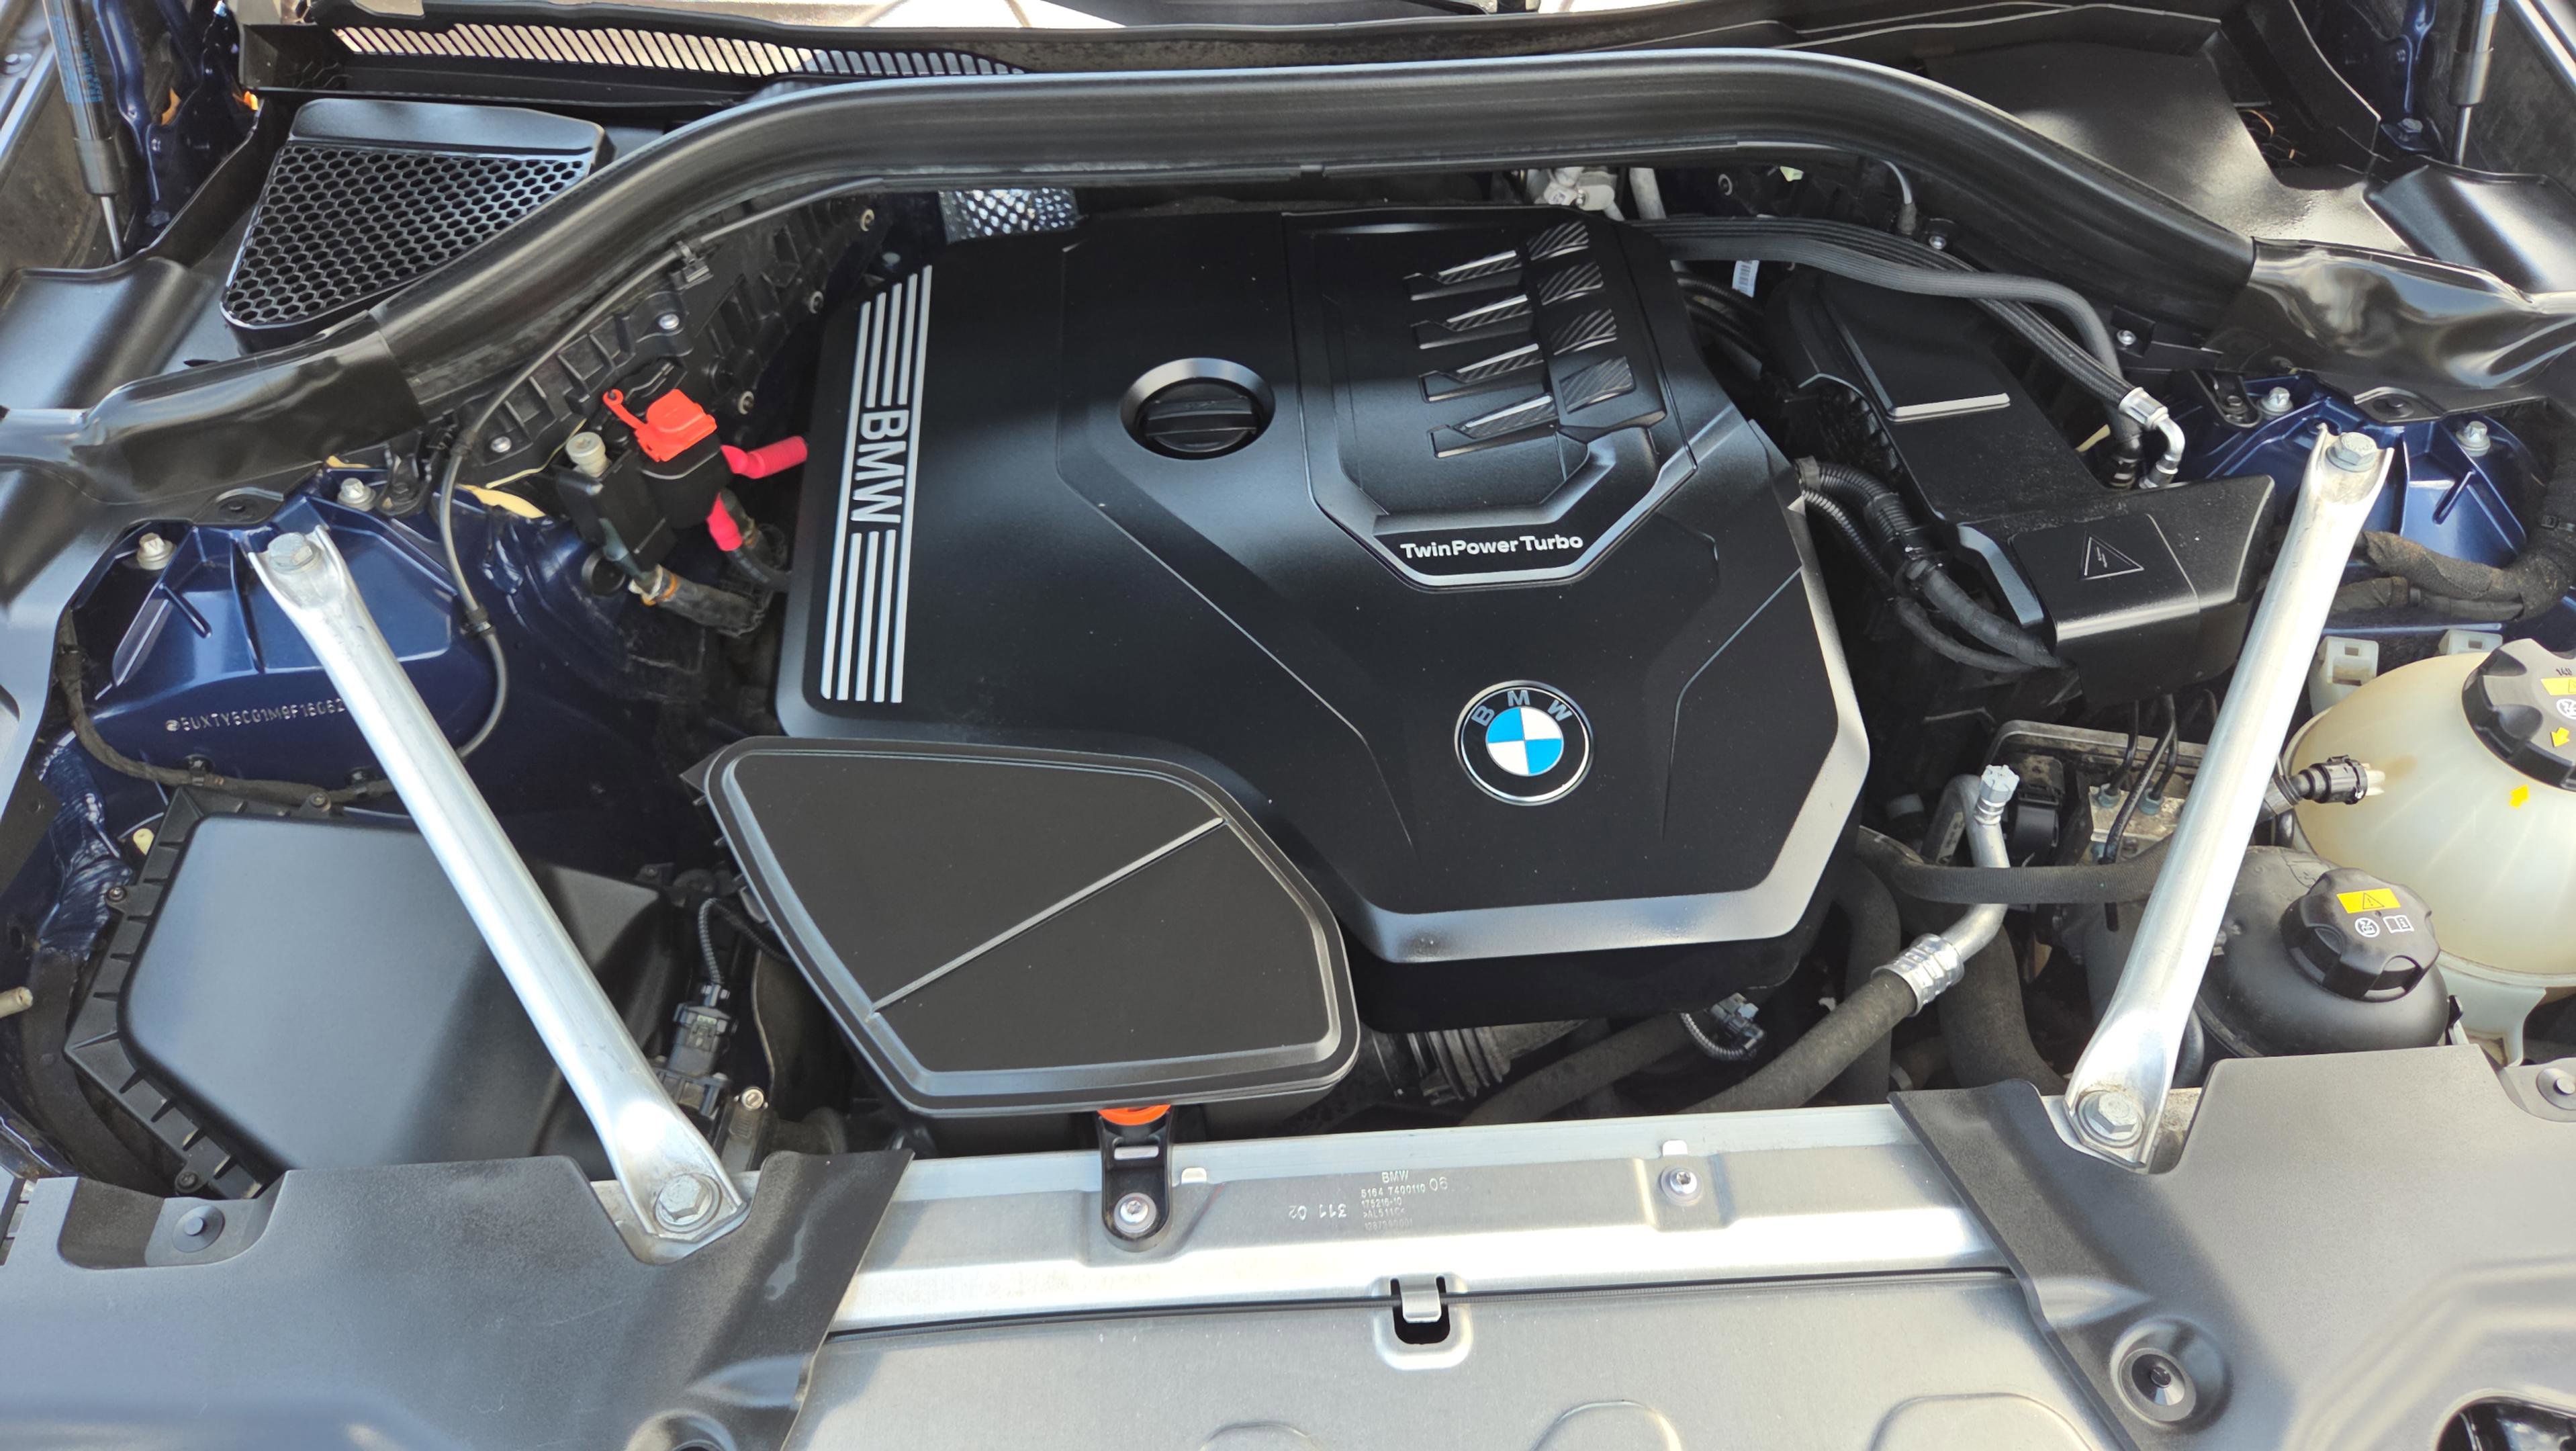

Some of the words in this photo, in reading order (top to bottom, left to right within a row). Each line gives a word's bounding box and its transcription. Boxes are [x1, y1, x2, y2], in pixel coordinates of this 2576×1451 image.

[850, 409, 909, 523] BMW
[1400, 539, 1518, 558] TwinPower
[1519, 534, 1583, 551] Turbo
[1471, 690, 1573, 727] BMW
[1381, 1170, 1409, 1183] BMW
[1429, 1177, 1448, 1192] 06
[1361, 1188, 1384, 1198] 5164
[1288, 1204, 1308, 1221] 02
[1318, 1203, 1348, 1219] 311
